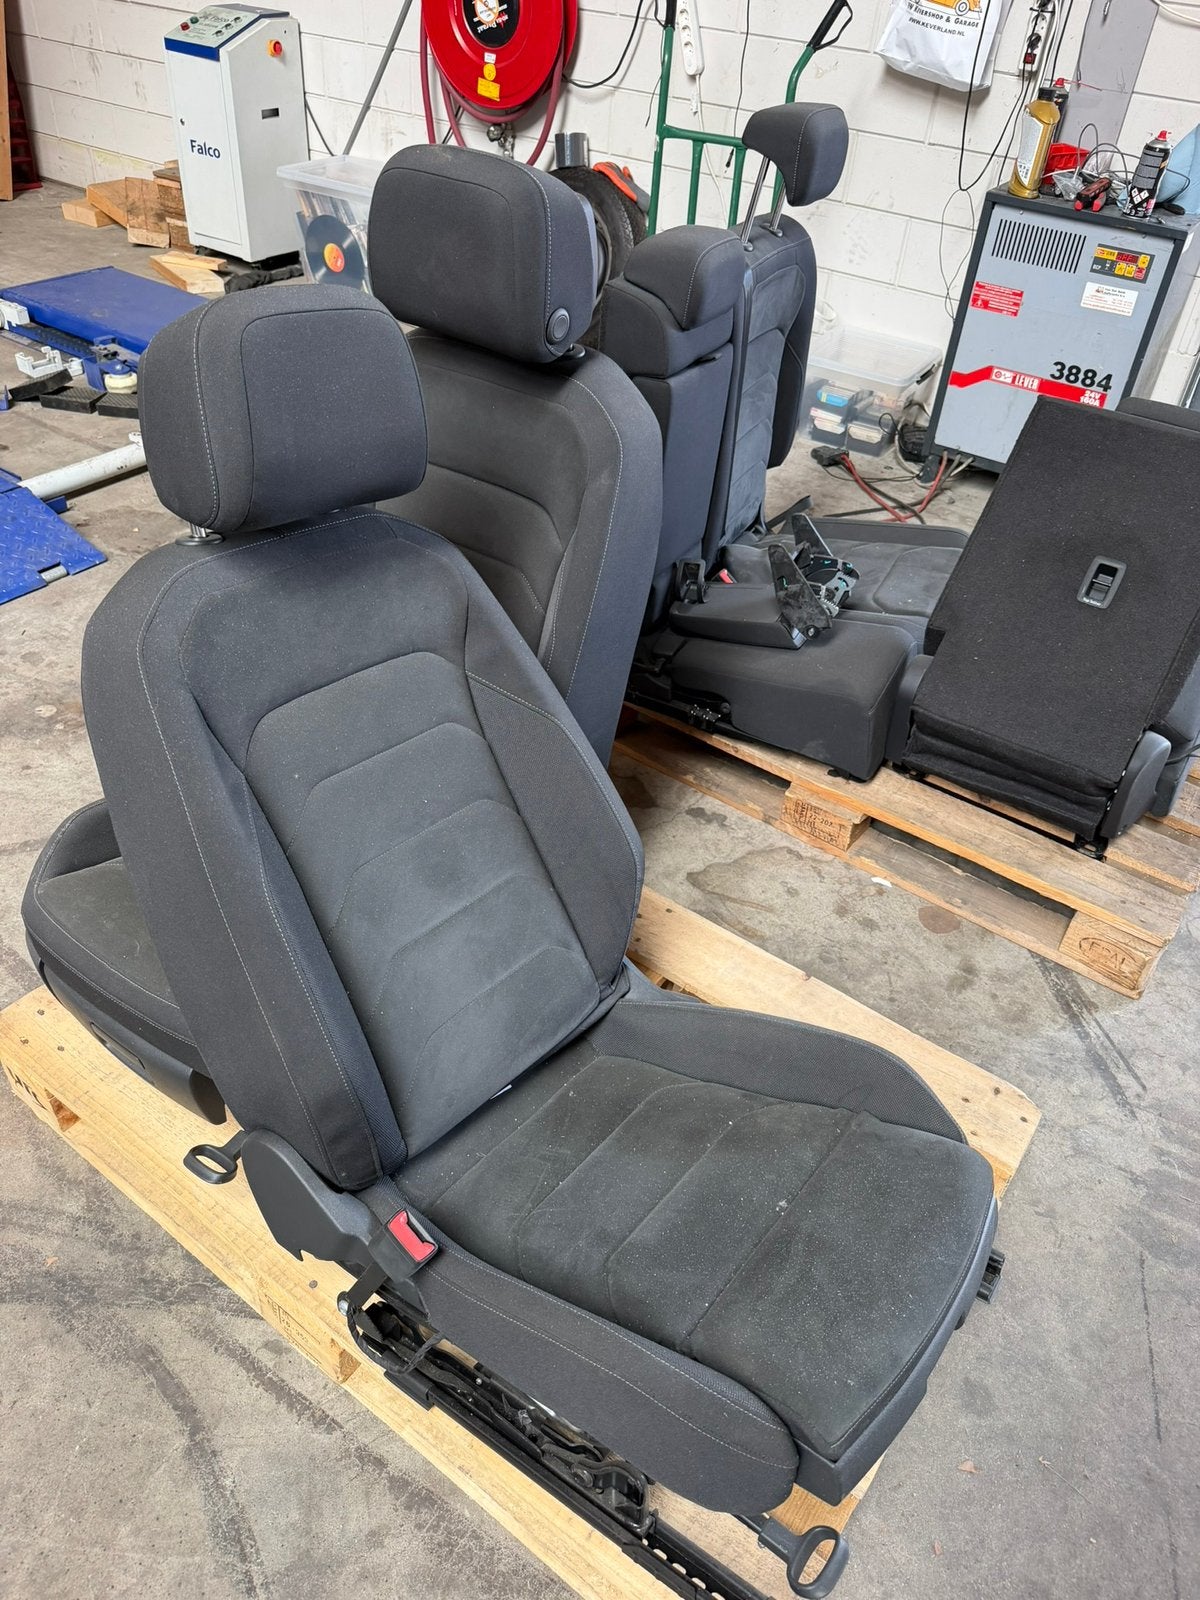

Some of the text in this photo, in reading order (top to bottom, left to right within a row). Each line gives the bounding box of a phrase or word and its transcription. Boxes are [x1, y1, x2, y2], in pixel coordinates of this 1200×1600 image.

[954, 18, 980, 28] GARAGE
[190, 139, 221, 159] Falco
[1015, 373, 1039, 390] LEVER
[1049, 361, 1113, 392] 3884
[1080, 396, 1100, 407] 160A
[1084, 390, 1102, 400] 24V
